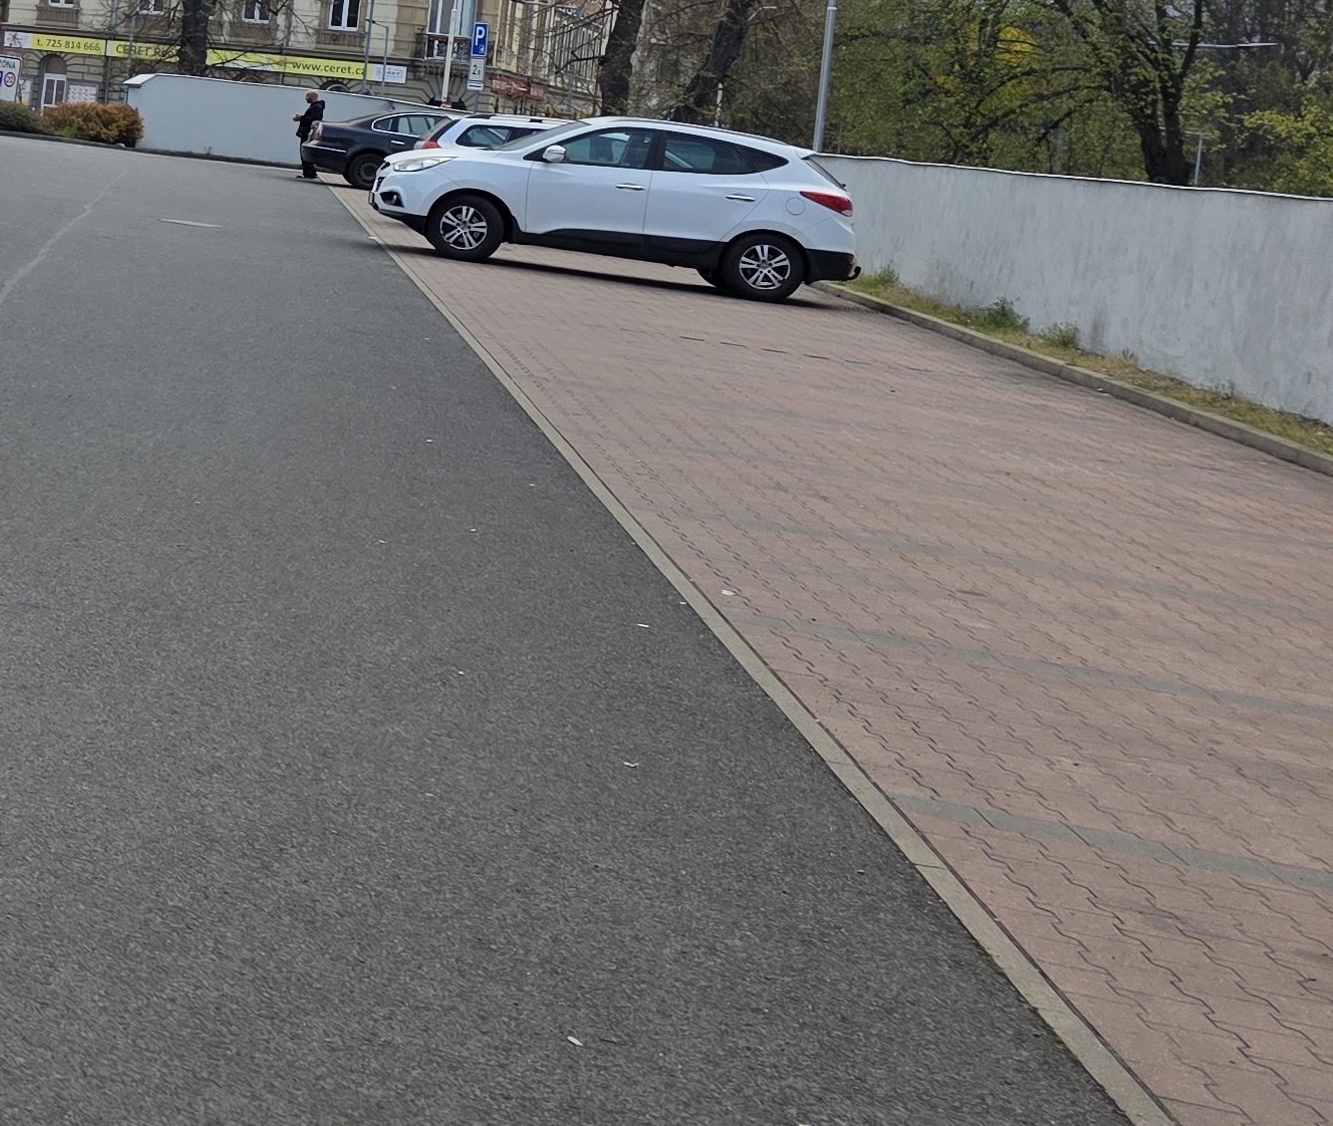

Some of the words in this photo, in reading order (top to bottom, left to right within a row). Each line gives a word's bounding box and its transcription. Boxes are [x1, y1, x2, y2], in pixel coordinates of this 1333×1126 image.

[475, 27, 485, 45] P
[46, 39, 62, 47] 725
[65, 41, 81, 49] 814
[83, 42, 101, 51] 666
[116, 44, 151, 56] CERET
